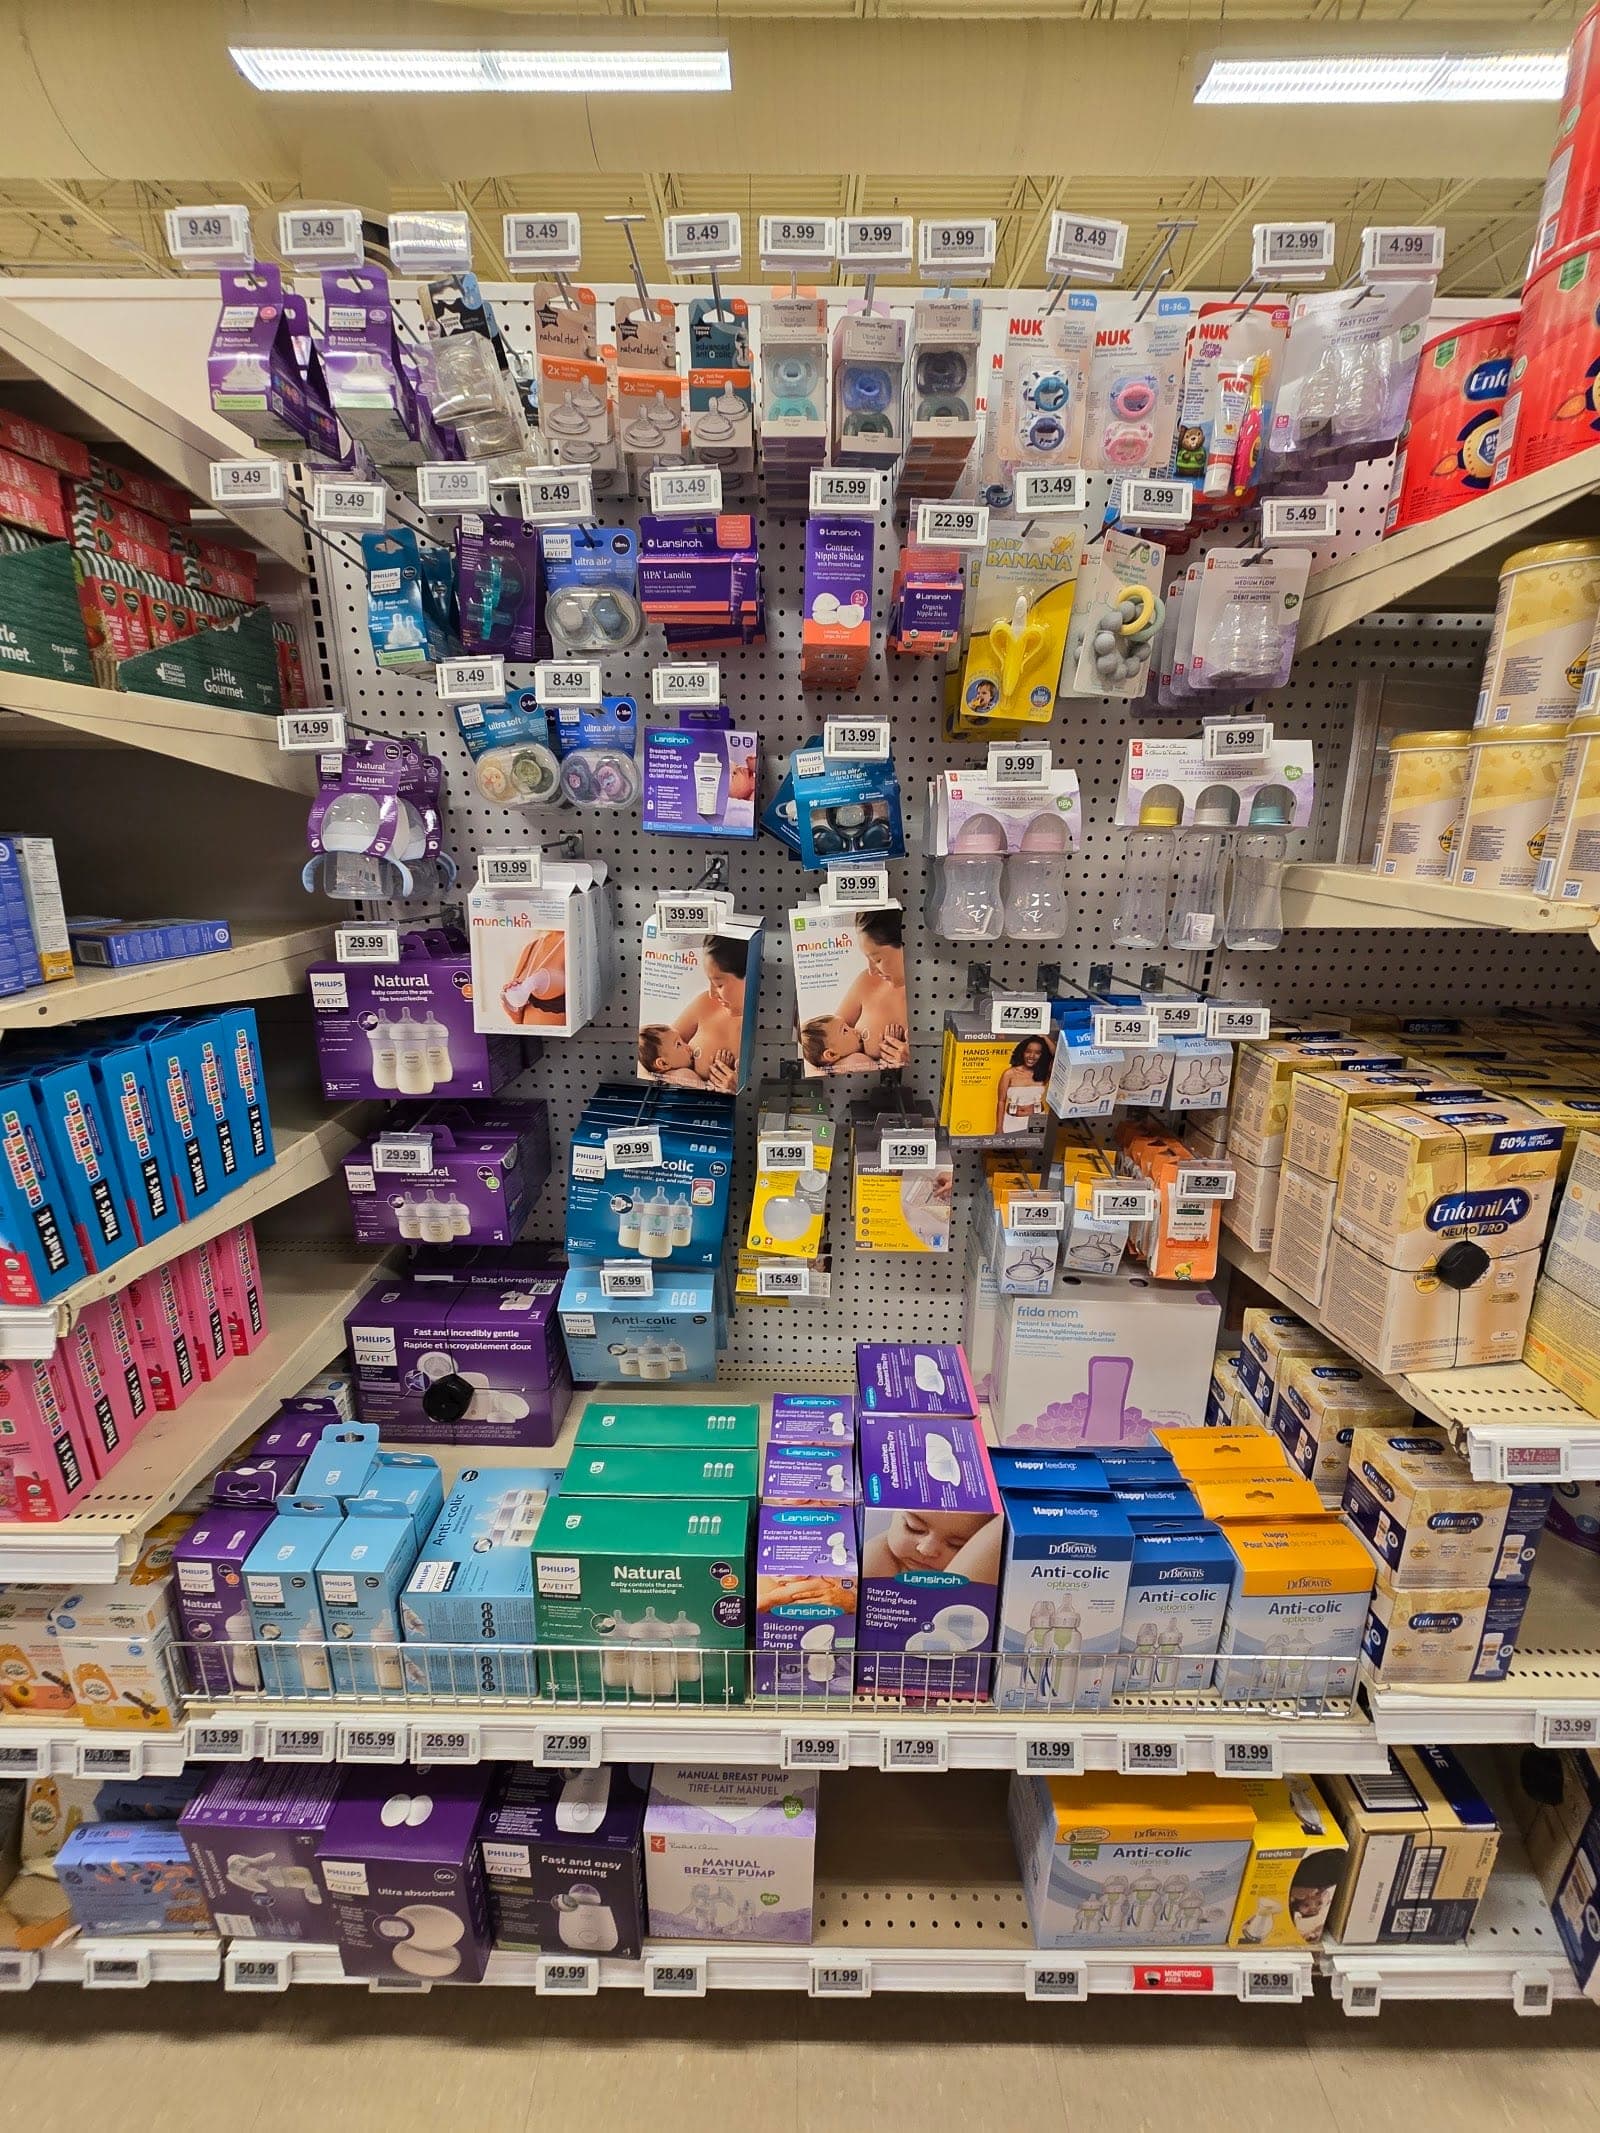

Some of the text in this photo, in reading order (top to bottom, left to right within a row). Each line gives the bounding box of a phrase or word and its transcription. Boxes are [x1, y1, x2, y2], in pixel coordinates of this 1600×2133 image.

[189, 220, 222, 236] 9.49
[302, 221, 334, 237] 9.49
[525, 224, 558, 240] 8.49
[686, 225, 719, 241] 8.49
[782, 224, 814, 240] 8.99
[859, 225, 892, 241] 9.99
[941, 231, 974, 247] 9.99
[1073, 228, 1107, 246] 8.49
[1276, 233, 1318, 249] 12.99
[1390, 238, 1423, 252] 4.99
[1009, 319, 1043, 335] NUK
[1199, 324, 1229, 340] NUK
[1096, 329, 1130, 346] NUK
[548, 366, 560, 374] 2x
[624, 383, 635, 391] 2x
[231, 470, 261, 483] 9.49
[438, 475, 468, 489] 7.99
[667, 479, 706, 494] 13.49
[827, 479, 866, 494] 15.99
[1030, 479, 1072, 494] 13.49
[540, 486, 570, 501] 8.49
[1143, 490, 1174, 503] 8.99
[335, 494, 365, 507] 9.49
[935, 514, 973, 528] 22.99
[1286, 508, 1317, 522] 5.49
[657, 539, 702, 548] Lansinoh
[826, 544, 854, 552] Contact
[815, 552, 838, 560] Nipple
[986, 553, 1071, 571] BANANA
[664, 571, 691, 579] Lanolin
[212, 667, 237, 685] Little
[456, 670, 484, 683] 8.49
[552, 674, 583, 687] 8.49
[668, 675, 705, 688] 20.49
[204, 679, 244, 698] Gourmet
[293, 721, 329, 735] 14.99
[840, 730, 876, 742] 13.99
[1226, 732, 1255, 745] 6.99
[356, 761, 386, 770] Natural
[1004, 758, 1035, 770] 9.99
[356, 776, 385, 784] Naturel
[492, 861, 528, 874] 19.99
[840, 877, 876, 890] 39.99
[473, 913, 531, 928] munchkin
[670, 908, 704, 921] 39.99
[350, 936, 383, 949] 29.99
[797, 934, 852, 951] munchkin
[645, 951, 698, 965] munchkin
[374, 974, 429, 987] Natural
[1004, 1008, 1039, 1019] 47.99
[1164, 1010, 1190, 1021] 5.49
[1227, 1015, 1253, 1026] 5.49
[1114, 1022, 1141, 1033] 5.49
[66, 1091, 98, 1180] CRUNCHABLES
[1500, 1136, 1526, 1149] 50%
[617, 1143, 649, 1155] 29.99
[769, 1147, 802, 1160] 14.99
[892, 1145, 926, 1157] 12.99
[5, 1112, 41, 1206] CRUNCHABLES
[386, 1150, 416, 1161] 29.99
[576, 1152, 603, 1161] PHILIPS
[1194, 1177, 1220, 1187] 5.29
[148, 1181, 164, 1216] That's
[1112, 1198, 1137, 1208] 7.49
[1025, 1208, 1049, 1218] 7.49
[1433, 1198, 1503, 1223] Enfamil
[100, 1201, 119, 1241] That's
[1480, 1223, 1504, 1233] PRO
[43, 1226, 65, 1270] That's
[612, 1276, 641, 1286] 26.99
[769, 1274, 798, 1285] 15.49
[1018, 1306, 1078, 1318] frida mom
[612, 1316, 676, 1325] Anti-colic
[451, 1329, 491, 1338] incredibly
[493, 1330, 519, 1338] gentle
[356, 1336, 391, 1344] PHILIPS
[404, 1342, 432, 1351] Rapide
[445, 1342, 508, 1351] incroyablement
[359, 1355, 390, 1363] AVENT
[1015, 1462, 1043, 1470] Happy
[781, 1513, 834, 1522] Lansinoh
[1033, 1507, 1063, 1516] Happy
[433, 1493, 466, 1547] Anti-colic
[541, 1565, 576, 1574] PHILIPS
[614, 1566, 681, 1580] Natural
[1031, 1565, 1110, 1579] Anti-colic
[904, 1574, 962, 1584] Lansinoh
[867, 1587, 900, 1598] Stay Dry
[1139, 1590, 1216, 1603] Anti-colic
[720, 1601, 740, 1609] Pure
[867, 1594, 897, 1605] Nursing
[254, 1610, 293, 1618] Anti-colic
[719, 1607, 741, 1616] glass
[780, 1607, 838, 1616] Lansinoh
[866, 1605, 910, 1616] Coussinets
[1269, 1602, 1342, 1615] Anti-colic
[763, 1623, 804, 1632] Silicone
[866, 1620, 882, 1628] Stay
[763, 1632, 797, 1640] Breast
[763, 1641, 793, 1650] Pump
[1554, 1720, 1591, 1732] 33.99
[202, 1731, 238, 1743] 13.99
[281, 1733, 319, 1745] 11.99
[349, 1733, 395, 1745] 165.99
[426, 1735, 464, 1747] 26.99
[547, 1736, 587, 1749] 27.99
[796, 1741, 834, 1752] 19.99
[896, 1741, 933, 1753] 17.99
[1031, 1742, 1070, 1756] 18.99
[1134, 1744, 1172, 1757] 18.99
[1229, 1745, 1268, 1759] 18.99
[678, 1770, 789, 1783] MANUAL BREAST PUMP
[688, 1783, 778, 1795] TIRE-LAIT MANUEL
[487, 1850, 526, 1859] PHILIPS
[1113, 1847, 1192, 1859] Anti-colic
[541, 1855, 622, 1871] Fast and easy
[702, 1858, 760, 1868] MANUAL
[557, 1866, 608, 1878] warming
[684, 1866, 775, 1878] BREAST PUMP
[378, 1889, 455, 1897] Ultra absorbent
[238, 1962, 275, 1975] 50.99
[548, 1967, 585, 1979] 49.99
[657, 1968, 693, 1980] 28.49
[1164, 1970, 1202, 1979] MONITORED
[824, 1970, 857, 1981] 11.99
[1038, 1972, 1075, 1985] 42.99
[1254, 1974, 1288, 1986] 26.99
